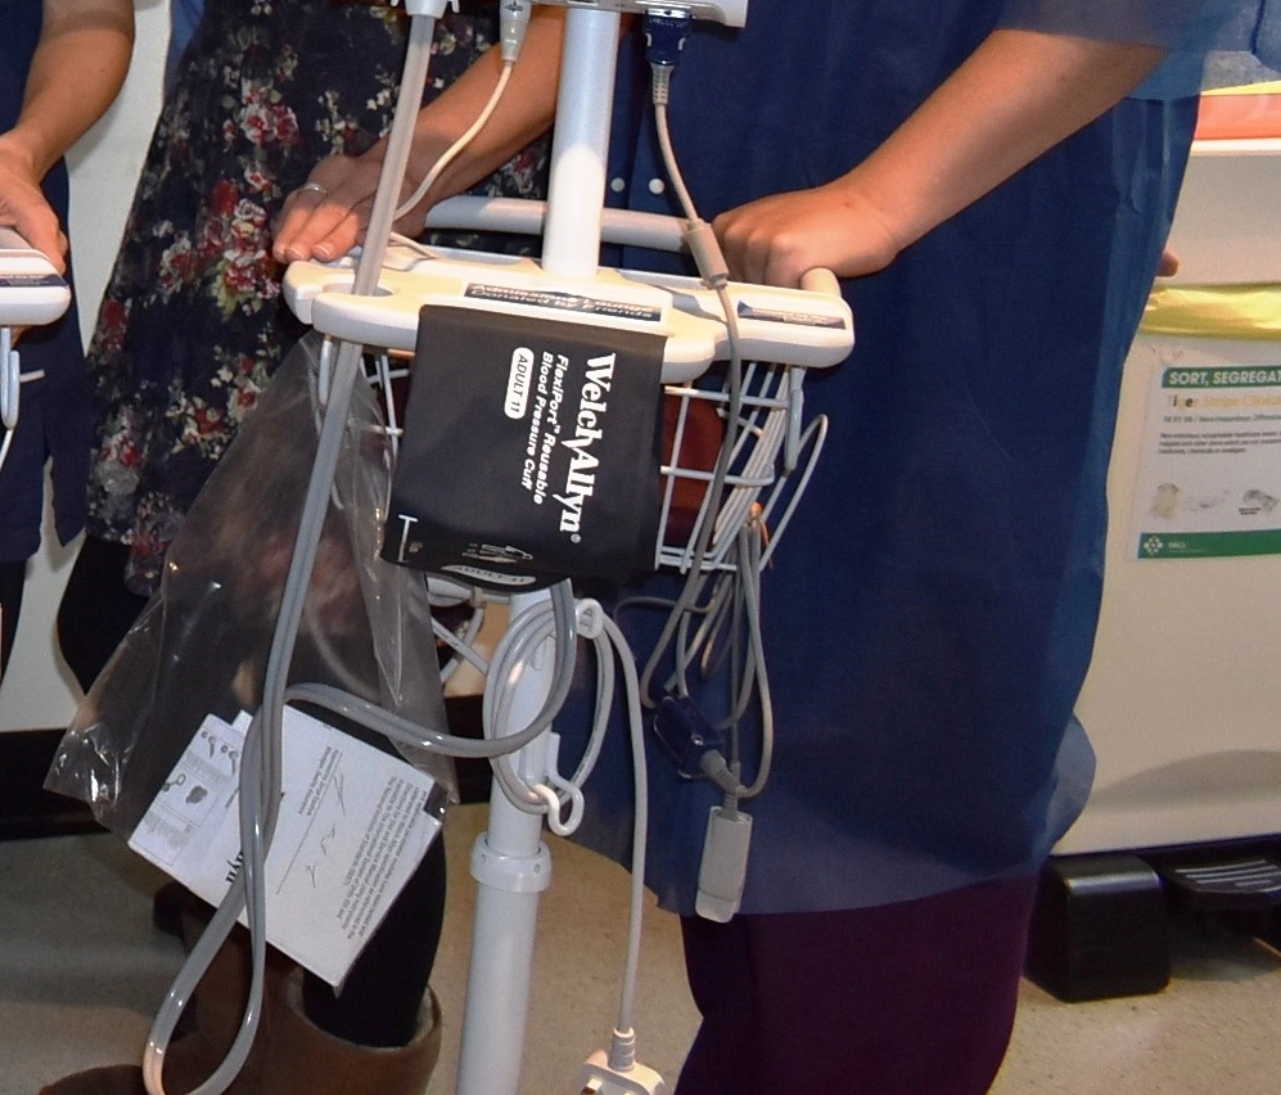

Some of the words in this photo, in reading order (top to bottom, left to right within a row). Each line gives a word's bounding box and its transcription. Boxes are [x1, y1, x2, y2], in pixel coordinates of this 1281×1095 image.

[515, 354, 530, 398] ADULT
[538, 352, 554, 395] Blood
[1169, 372, 1209, 385] SORT,
[509, 400, 522, 415] 11
[528, 396, 546, 456] Pressure
[521, 457, 536, 490] Cuff
[534, 433, 556, 505] Reusable
